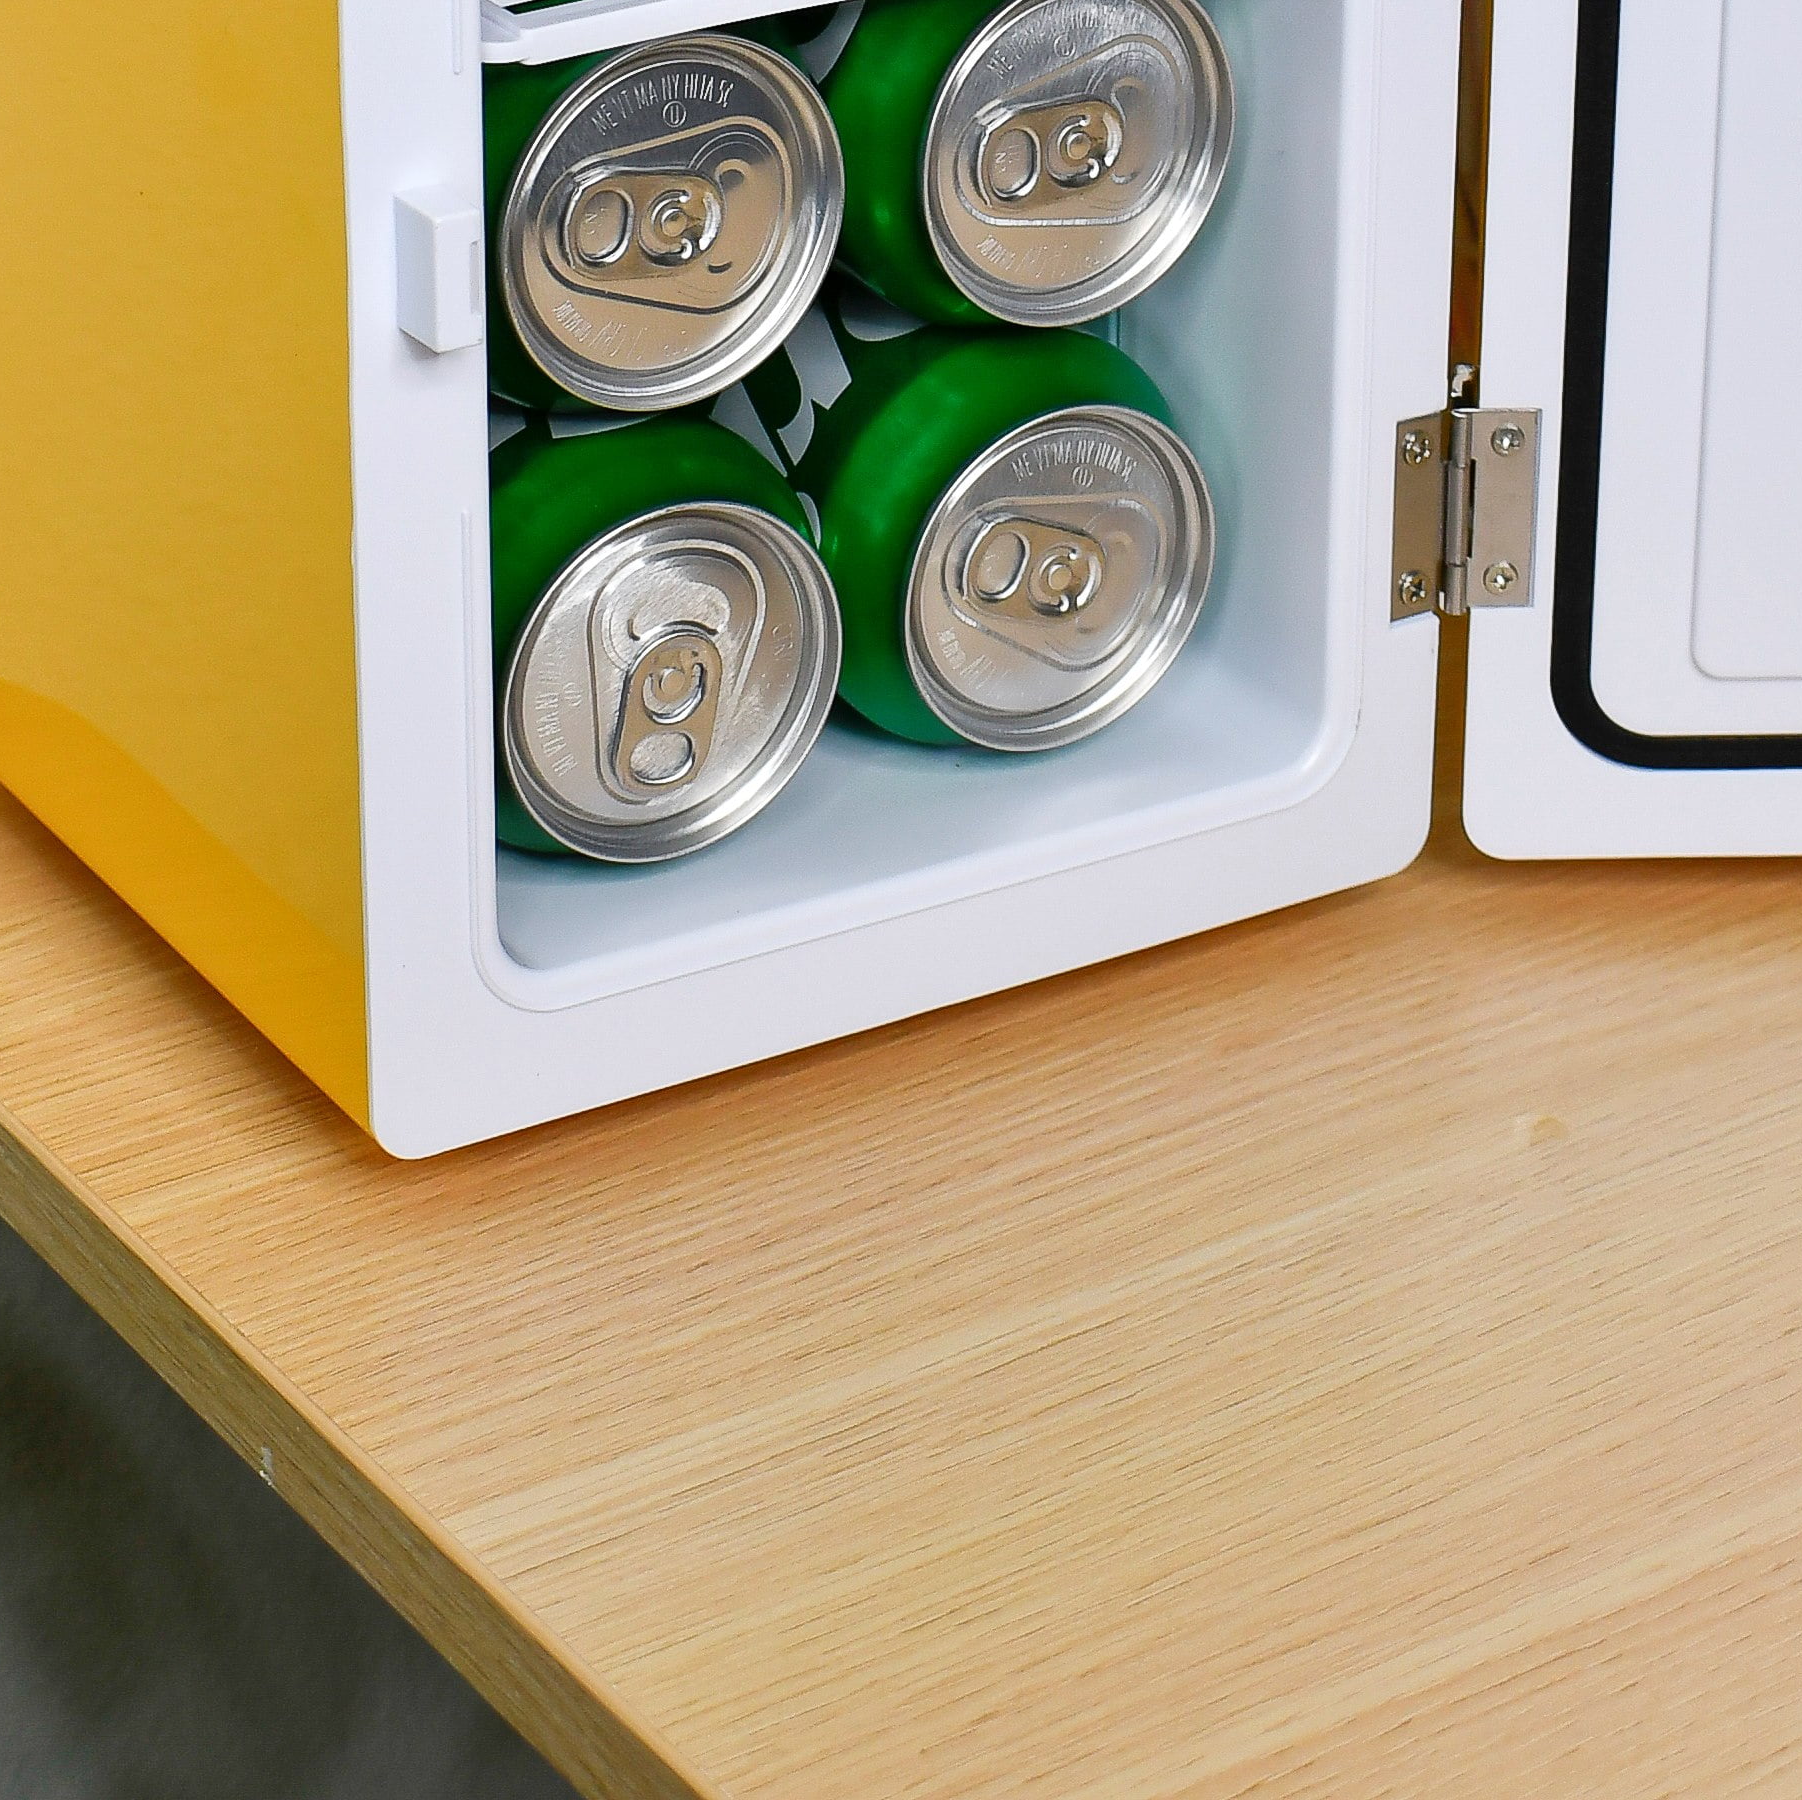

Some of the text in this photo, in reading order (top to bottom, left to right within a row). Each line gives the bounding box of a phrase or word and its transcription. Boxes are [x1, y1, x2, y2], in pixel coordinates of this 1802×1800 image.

[590, 103, 619, 136] ME
[633, 79, 660, 110] MA
[661, 73, 681, 101] NY
